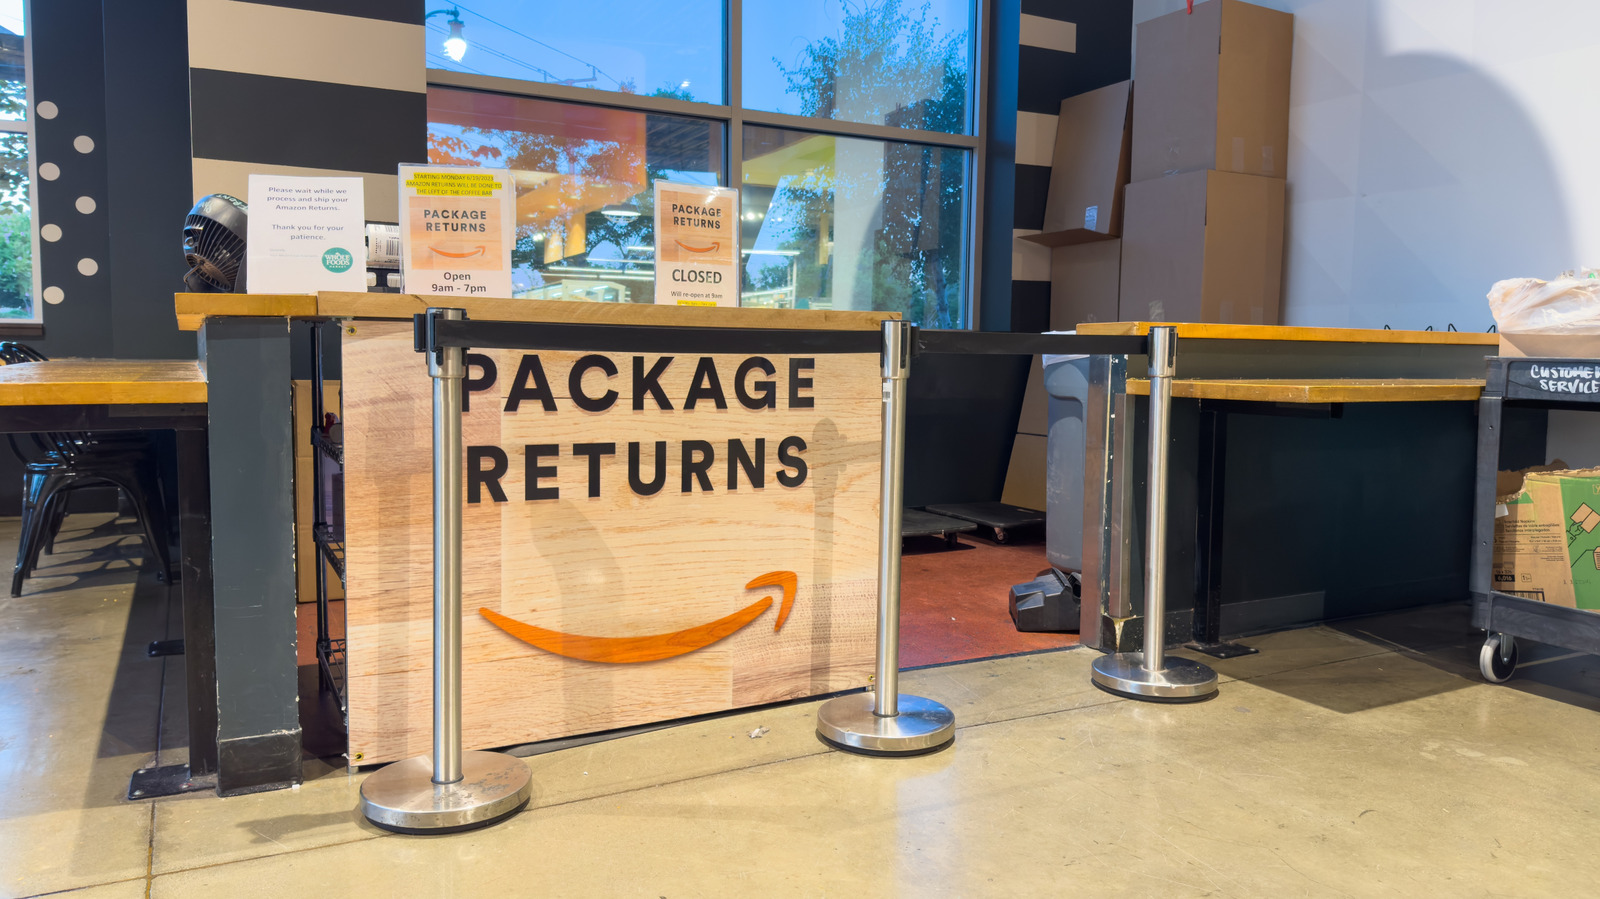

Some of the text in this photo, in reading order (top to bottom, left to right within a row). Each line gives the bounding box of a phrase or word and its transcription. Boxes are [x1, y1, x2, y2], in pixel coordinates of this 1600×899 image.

[424, 209, 487, 220] PACKAGE
[672, 204, 721, 217] PACKAGE
[426, 222, 486, 232] RETURNS
[674, 217, 721, 229] RETURNS
[444, 272, 471, 282] Open
[672, 269, 722, 284] CLOSED
[432, 284, 454, 292] 9am
[464, 284, 487, 294] 7pm
[462, 354, 815, 412] PACKAGE
[1539, 379, 1600, 394] SERVICE
[467, 435, 809, 504] RETURNS
